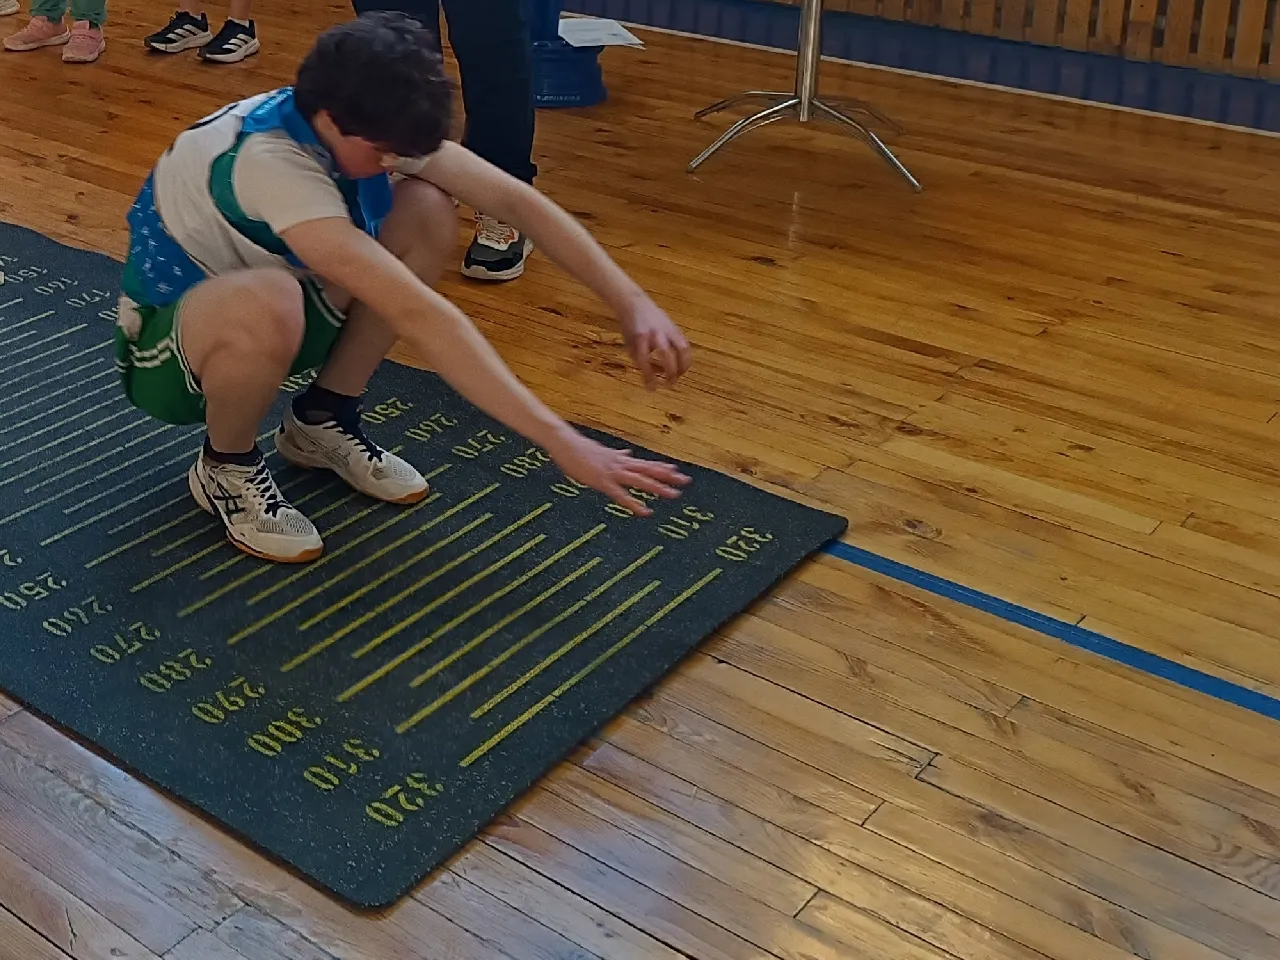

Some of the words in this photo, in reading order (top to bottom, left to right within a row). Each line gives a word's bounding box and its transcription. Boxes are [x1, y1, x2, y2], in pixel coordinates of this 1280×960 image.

[4, 265, 48, 284] 150
[34, 276, 79, 295] 160
[65, 289, 111, 308] 170
[360, 396, 414, 424] 250
[404, 412, 459, 441] 260
[451, 429, 506, 459] 270
[499, 447, 552, 478] 280
[657, 506, 715, 540] 310
[715, 527, 773, 561] 320
[42, 595, 113, 637] 260
[89, 621, 161, 664] 270
[138, 647, 213, 693] 280
[191, 674, 266, 724] 290
[246, 706, 322, 757] 300
[303, 738, 380, 791] 310
[365, 771, 445, 828] 320
